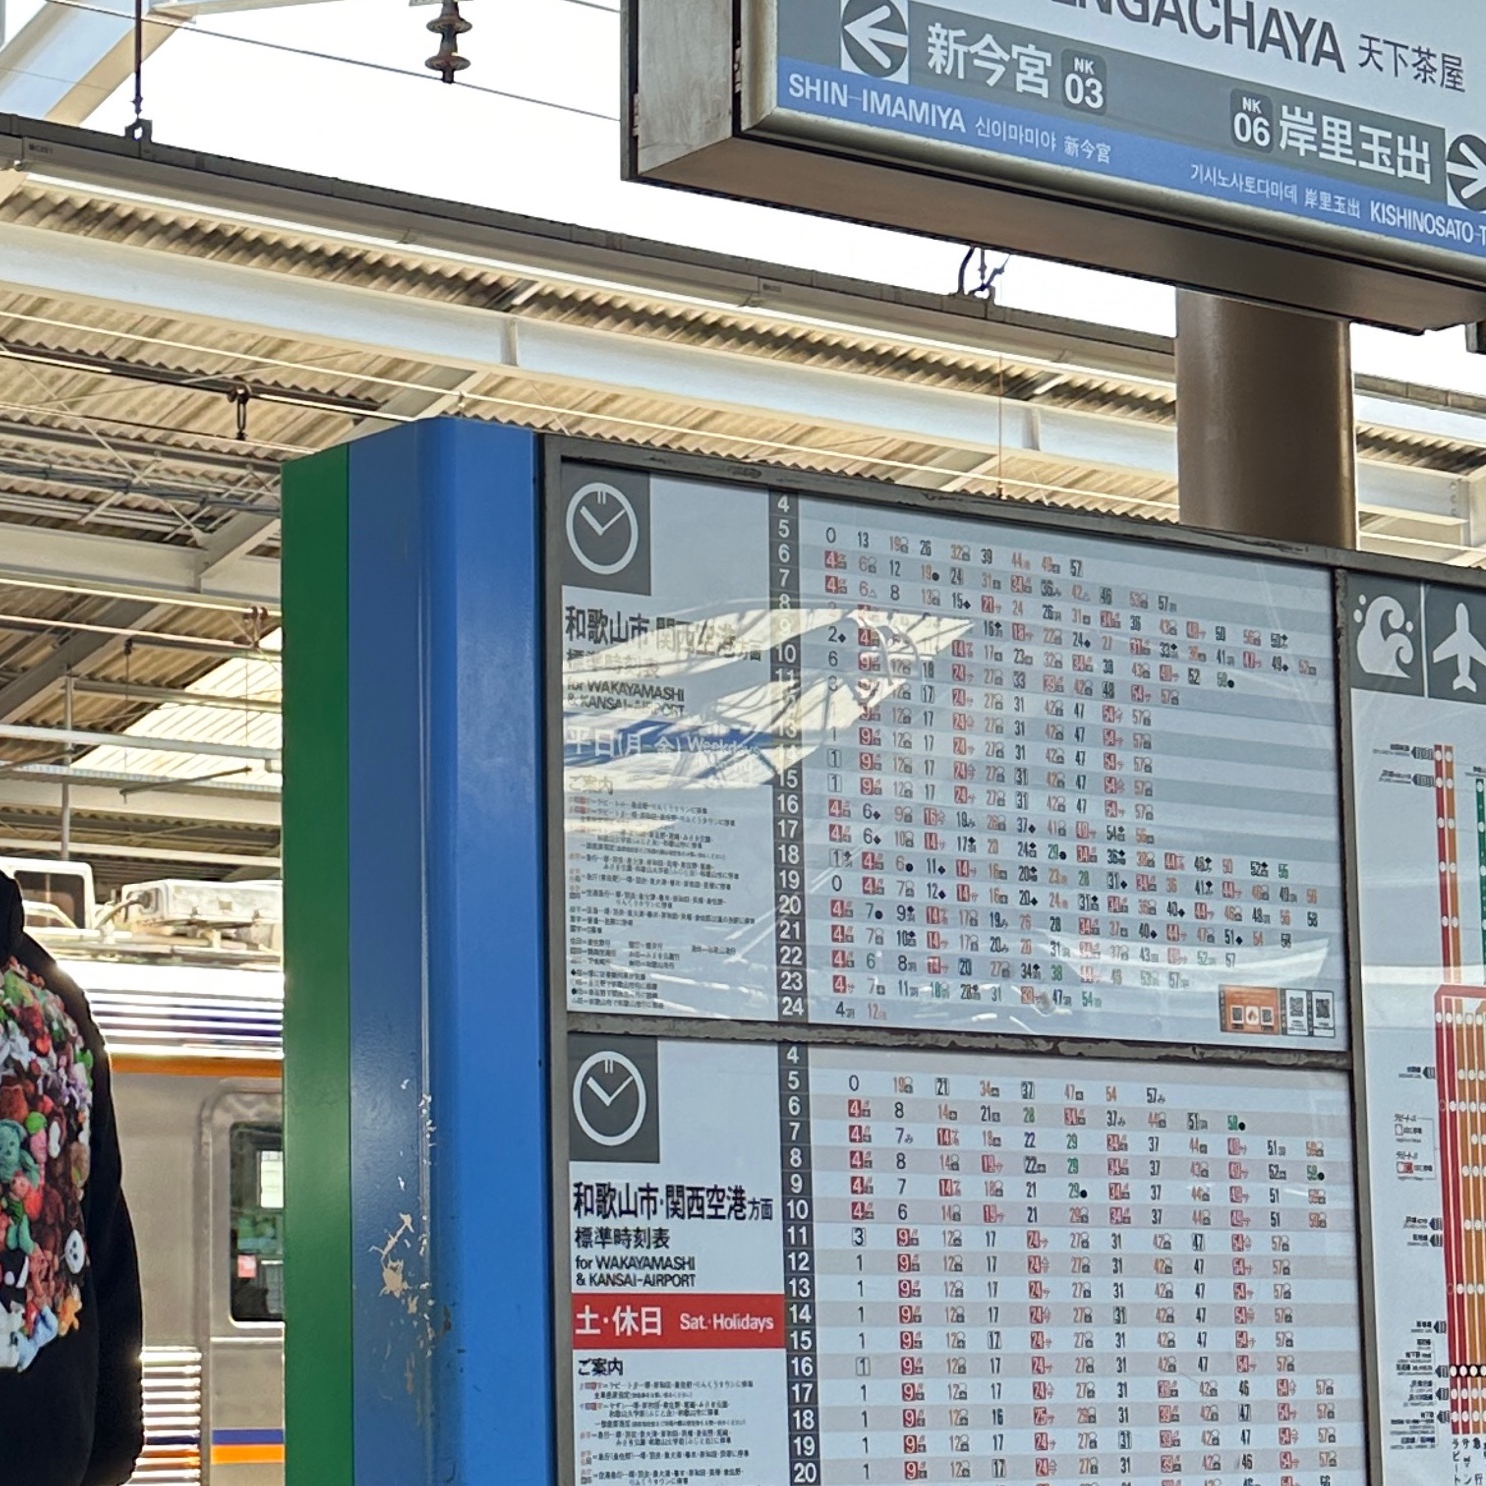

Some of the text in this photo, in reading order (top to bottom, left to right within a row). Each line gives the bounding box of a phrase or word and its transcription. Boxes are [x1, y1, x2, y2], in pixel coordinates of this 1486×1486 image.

[927, 23, 1052, 98] 新今宮
[1074, 57, 1095, 75] NK
[1358, 33, 1465, 92] 天下茶屋
[1064, 74, 1104, 108] 03
[1242, 97, 1261, 113] NK
[975, 117, 1056, 152] 신이마미야
[1233, 113, 1270, 147] 06
[1279, 105, 1431, 184] 岸里玉出
[777, 496, 789, 513] 4
[778, 520, 869, 548] 5 0 13
[778, 544, 900, 576] 6 12
[779, 570, 789, 587] 7
[891, 585, 899, 600] 8
[775, 644, 837, 666] 10 6
[778, 770, 798, 788] 15
[778, 794, 872, 819] 16 6
[778, 820, 873, 844] 17 6
[779, 845, 798, 864] 18
[780, 870, 842, 891] 19 0
[779, 895, 801, 914] 20
[779, 920, 800, 940] 21
[780, 946, 802, 965] 22
[781, 971, 803, 990] 23
[782, 996, 804, 1016] 24
[786, 1047, 798, 1063] 4
[788, 1071, 799, 1089] 5
[849, 1074, 859, 1091] 0
[788, 1096, 800, 1115] 6
[895, 1102, 904, 1118] 8
[789, 1123, 800, 1140] 7
[895, 1128, 904, 1144] 7
[1148, 1137, 1159, 1151] 37
[789, 1148, 1160, 1176] 8 8 37
[791, 1174, 802, 1193] 9
[898, 1179, 906, 1195] 7
[1027, 1182, 1036, 1198] 21
[1151, 1184, 1161, 1200] 37
[787, 1200, 808, 1219] 10
[898, 1204, 907, 1220] 6
[1027, 1206, 1037, 1222] 21
[1152, 1209, 1162, 1224] 37
[574, 1227, 670, 1249] 標準時刻表
[788, 1226, 807, 1244] 11
[855, 1228, 864, 1246] 3
[985, 1231, 996, 1247] 17
[575, 1255, 695, 1271] for WAKAYAMASHI
[788, 1253, 809, 1271] 12
[857, 1255, 862, 1271] 1
[987, 1256, 997, 1272] 17
[576, 1273, 696, 1288] & KANSAI-AIRPORT
[789, 1278, 811, 1297] 13
[857, 1280, 863, 1297] 1
[988, 1282, 998, 1298] 17
[789, 1305, 811, 1323] 14
[858, 1306, 864, 1322] 1
[988, 1307, 999, 1323] 17
[791, 1331, 812, 1350] 15
[859, 1333, 865, 1349] 1
[578, 1357, 623, 1377] ご案内
[792, 1357, 813, 1376] 16
[990, 1358, 1000, 1374] 17
[792, 1383, 813, 1402] 17
[861, 1384, 866, 1401] 1
[991, 1383, 1001, 1399] 17
[793, 1410, 814, 1429] 18
[862, 1411, 867, 1427] 1
[794, 1437, 815, 1456] 19
[862, 1437, 868, 1453] 1
[993, 1434, 1004, 1451] 17
[794, 1464, 816, 1482] 20
[863, 1464, 869, 1480] 1
